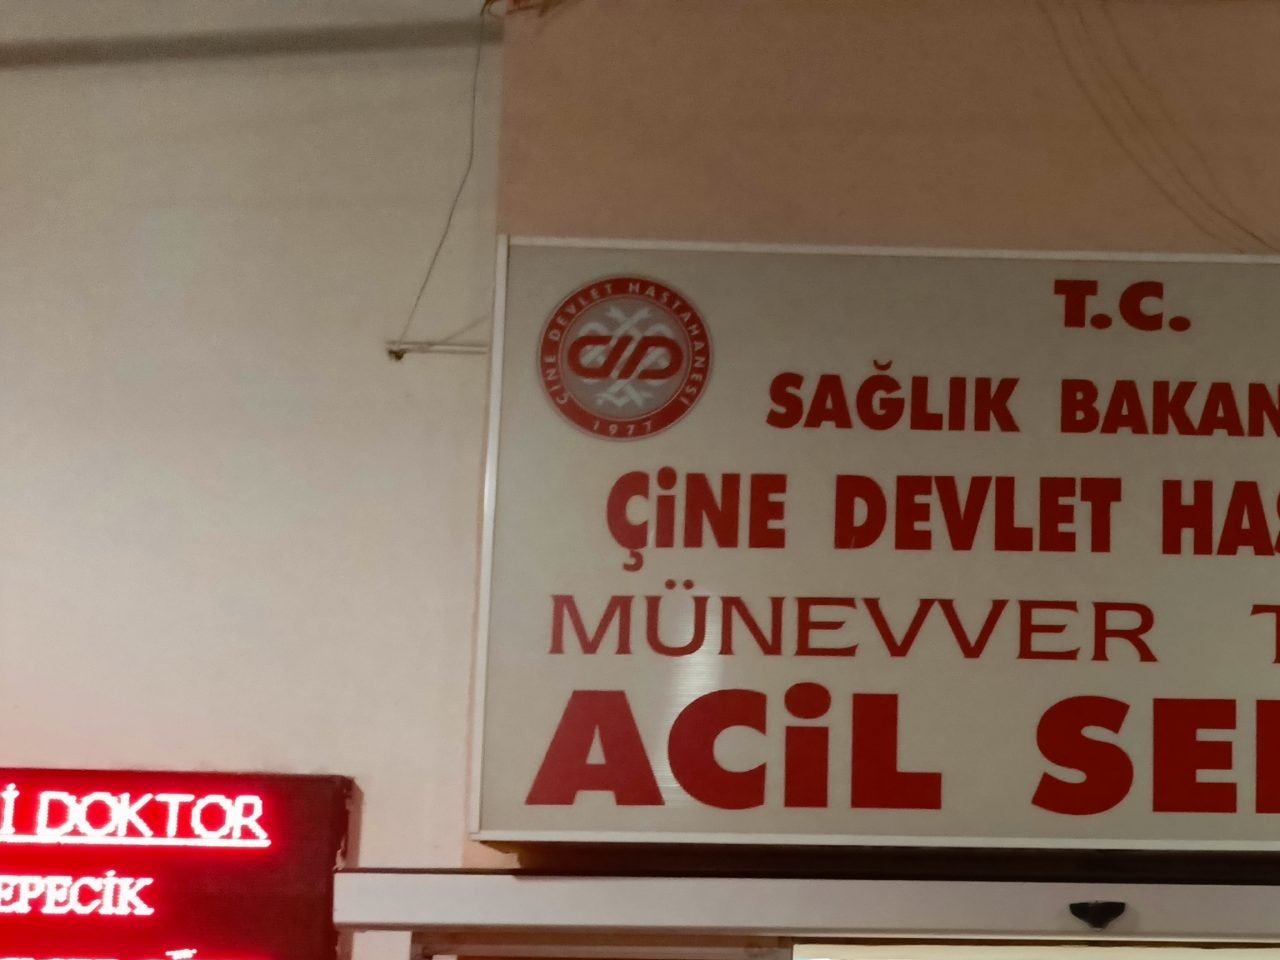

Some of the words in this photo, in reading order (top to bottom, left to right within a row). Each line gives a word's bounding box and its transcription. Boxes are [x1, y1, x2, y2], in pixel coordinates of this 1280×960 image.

[549, 284, 612, 340] DEVLET
[1054, 279, 1191, 332] T.C.
[766, 360, 1020, 433] SAĞLIK
[593, 421, 653, 436] 1977
[833, 474, 1122, 553] DEVLET
[548, 579, 1158, 662] MÜNEVVER
[35, 790, 268, 840] DOKTOR
